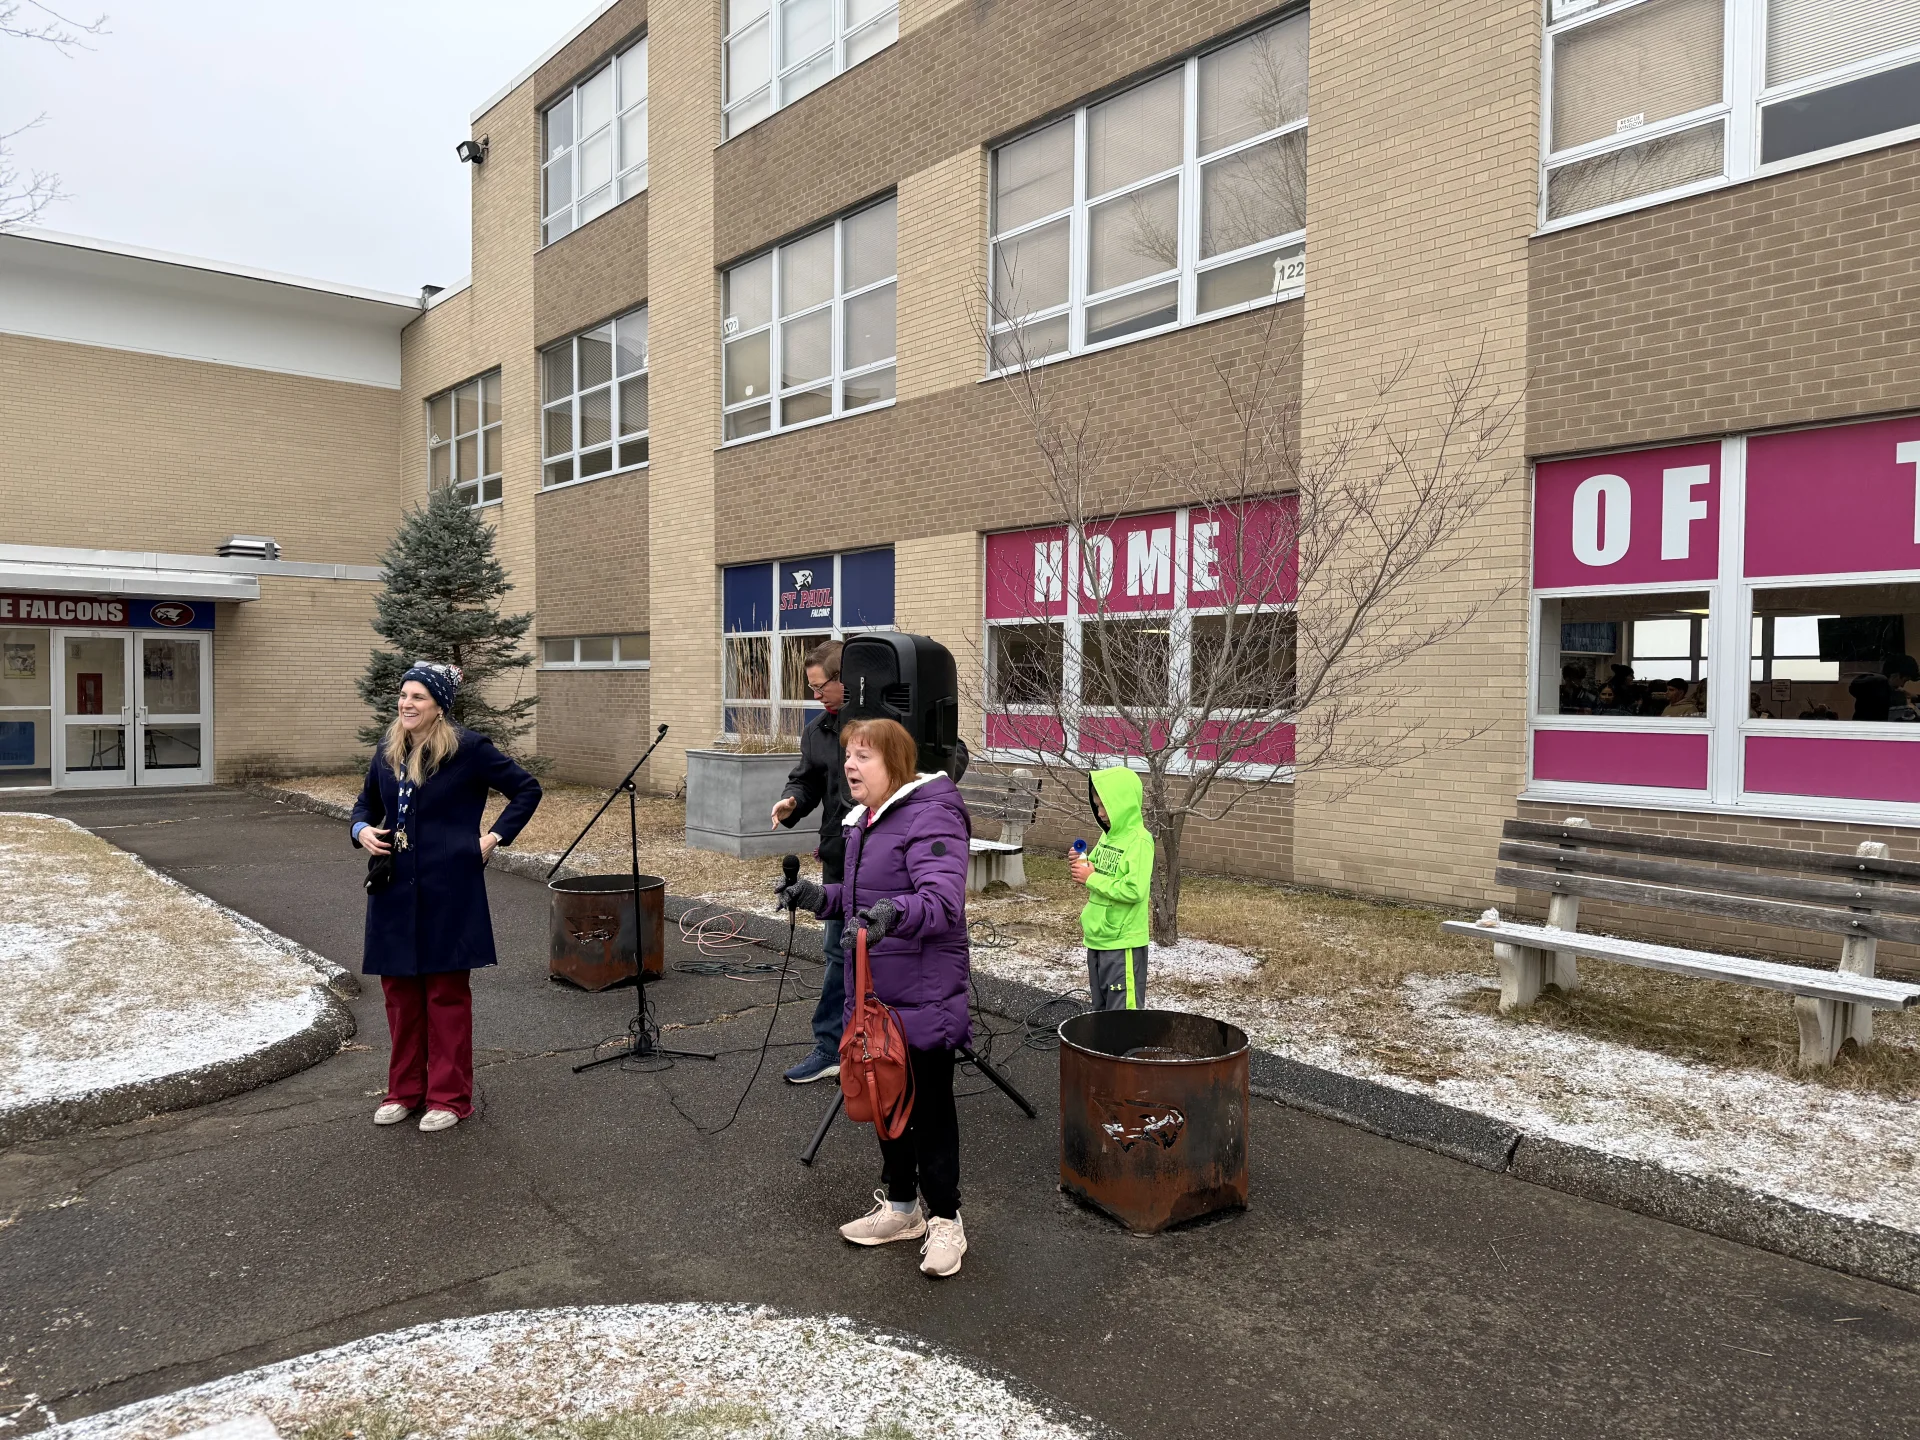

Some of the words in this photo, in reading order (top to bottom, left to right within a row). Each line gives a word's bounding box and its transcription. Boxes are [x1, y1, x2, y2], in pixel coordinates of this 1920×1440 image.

[1618, 119, 1643, 131] WINDOW
[1620, 115, 1641, 125] RESCUE
[1279, 261, 1305, 281] 122
[1571, 463, 1711, 567] OF
[1033, 521, 1220, 603] HOME
[780, 591, 798, 611] ST.
[799, 587, 832, 609] PAUL
[19, 599, 124, 622] FALCONS
[810, 608, 831, 618] FALCONS
